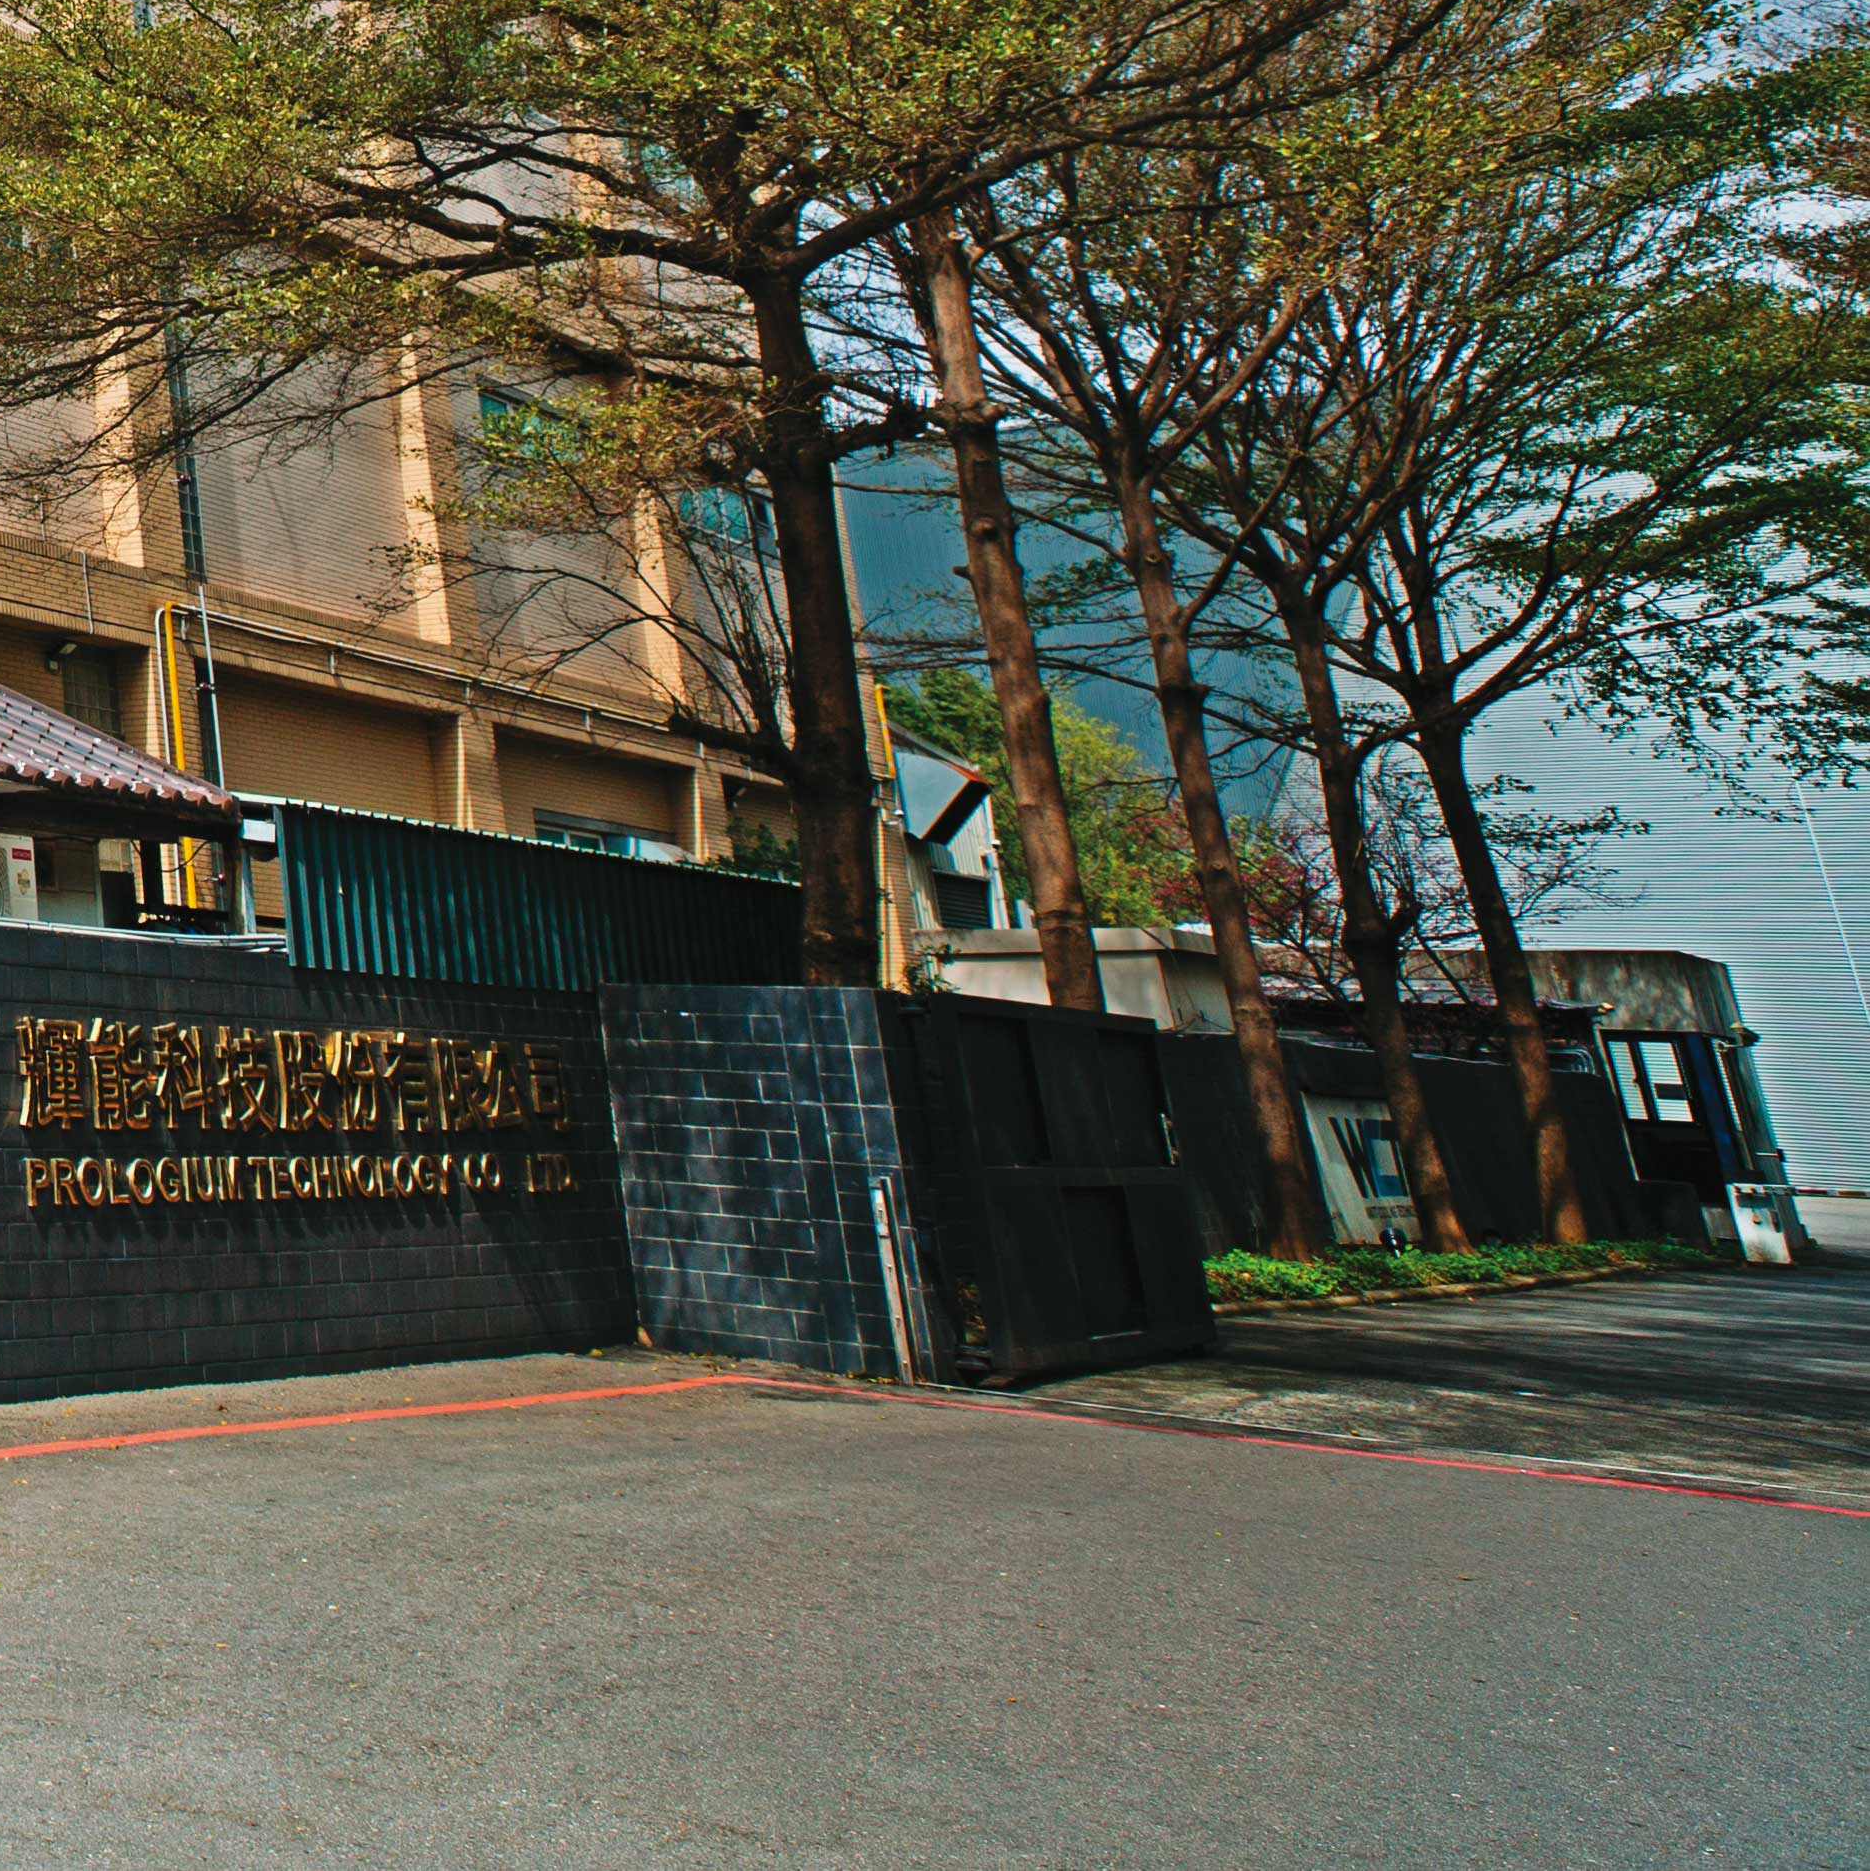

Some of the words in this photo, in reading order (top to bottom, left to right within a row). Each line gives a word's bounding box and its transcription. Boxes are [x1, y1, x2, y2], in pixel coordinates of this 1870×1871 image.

[16, 1015, 572, 1134] 輝能科技股份有限公司
[24, 1152, 243, 1208] PROLOGIUM
[247, 1152, 456, 1203] TECHNOLOGY
